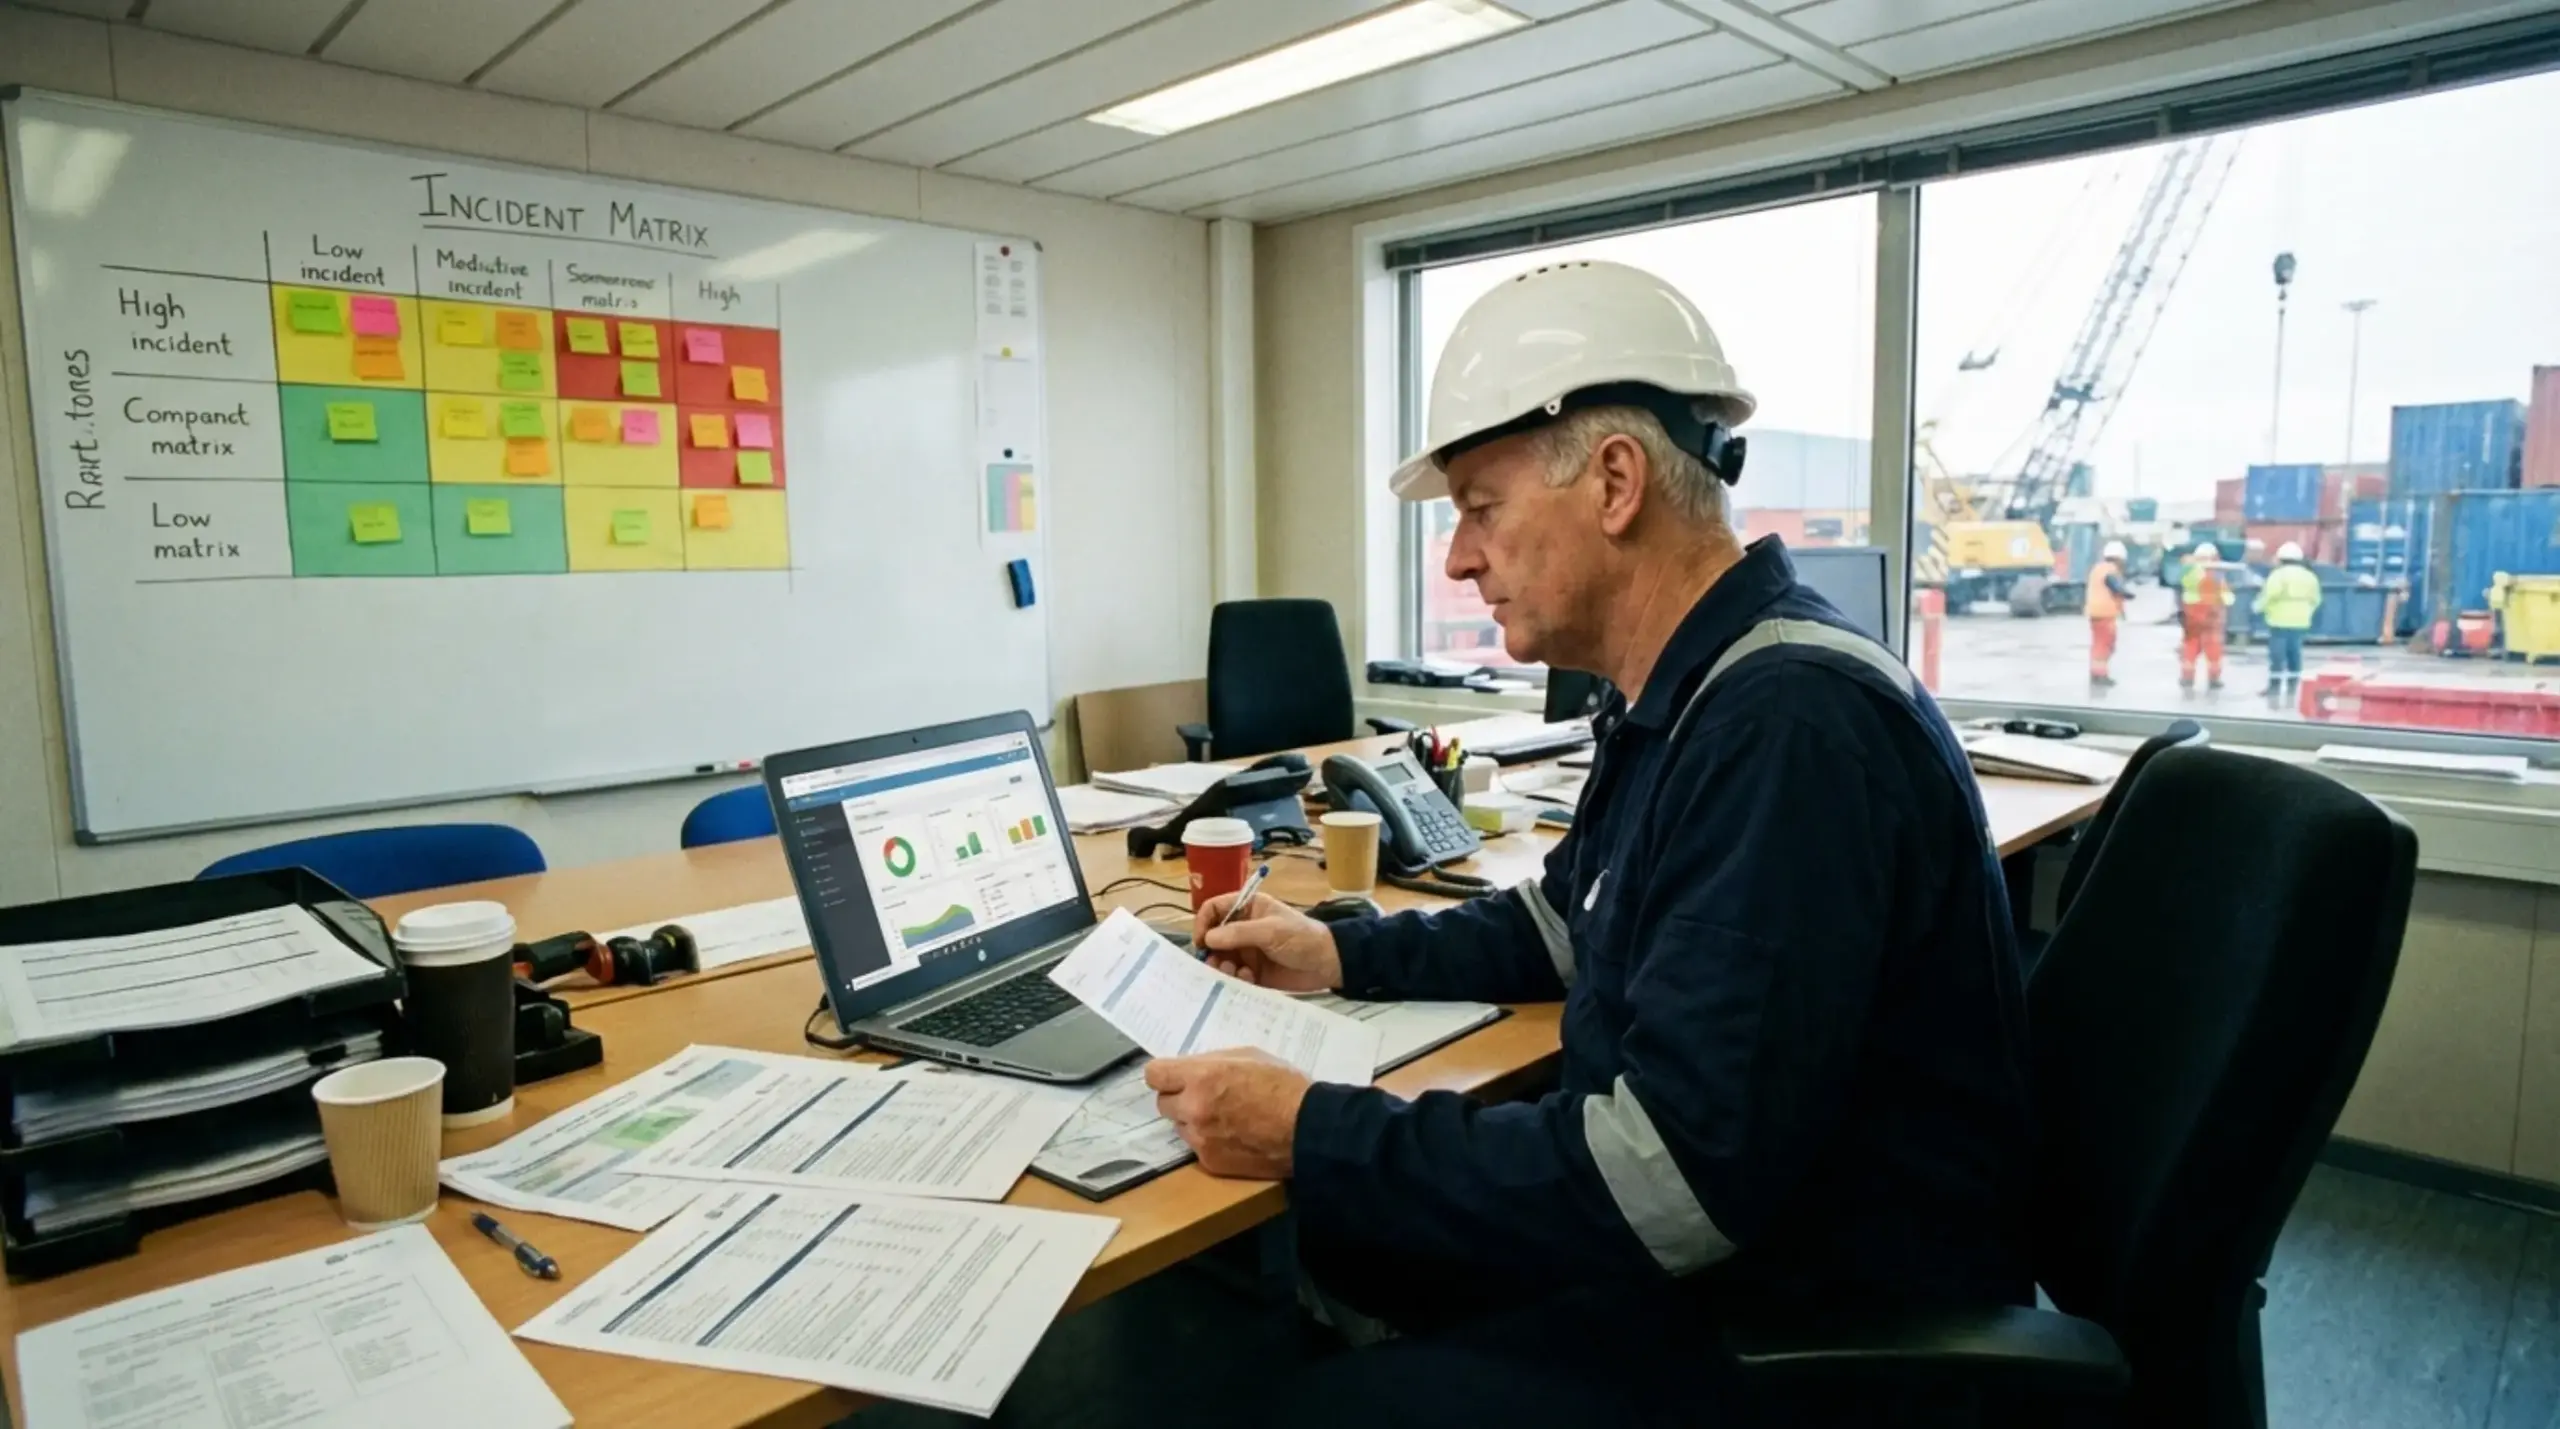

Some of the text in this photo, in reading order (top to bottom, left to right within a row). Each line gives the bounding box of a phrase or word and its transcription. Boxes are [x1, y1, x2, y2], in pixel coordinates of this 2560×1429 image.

[609, 201, 709, 248] MATRIX
[312, 233, 364, 259] Low
[300, 261, 386, 287] incident
[119, 287, 186, 329] High
[699, 279, 741, 312] High
[131, 331, 234, 357] incident
[151, 435, 236, 456] matrix
[152, 501, 212, 528] Low
[153, 537, 241, 560] matrix
